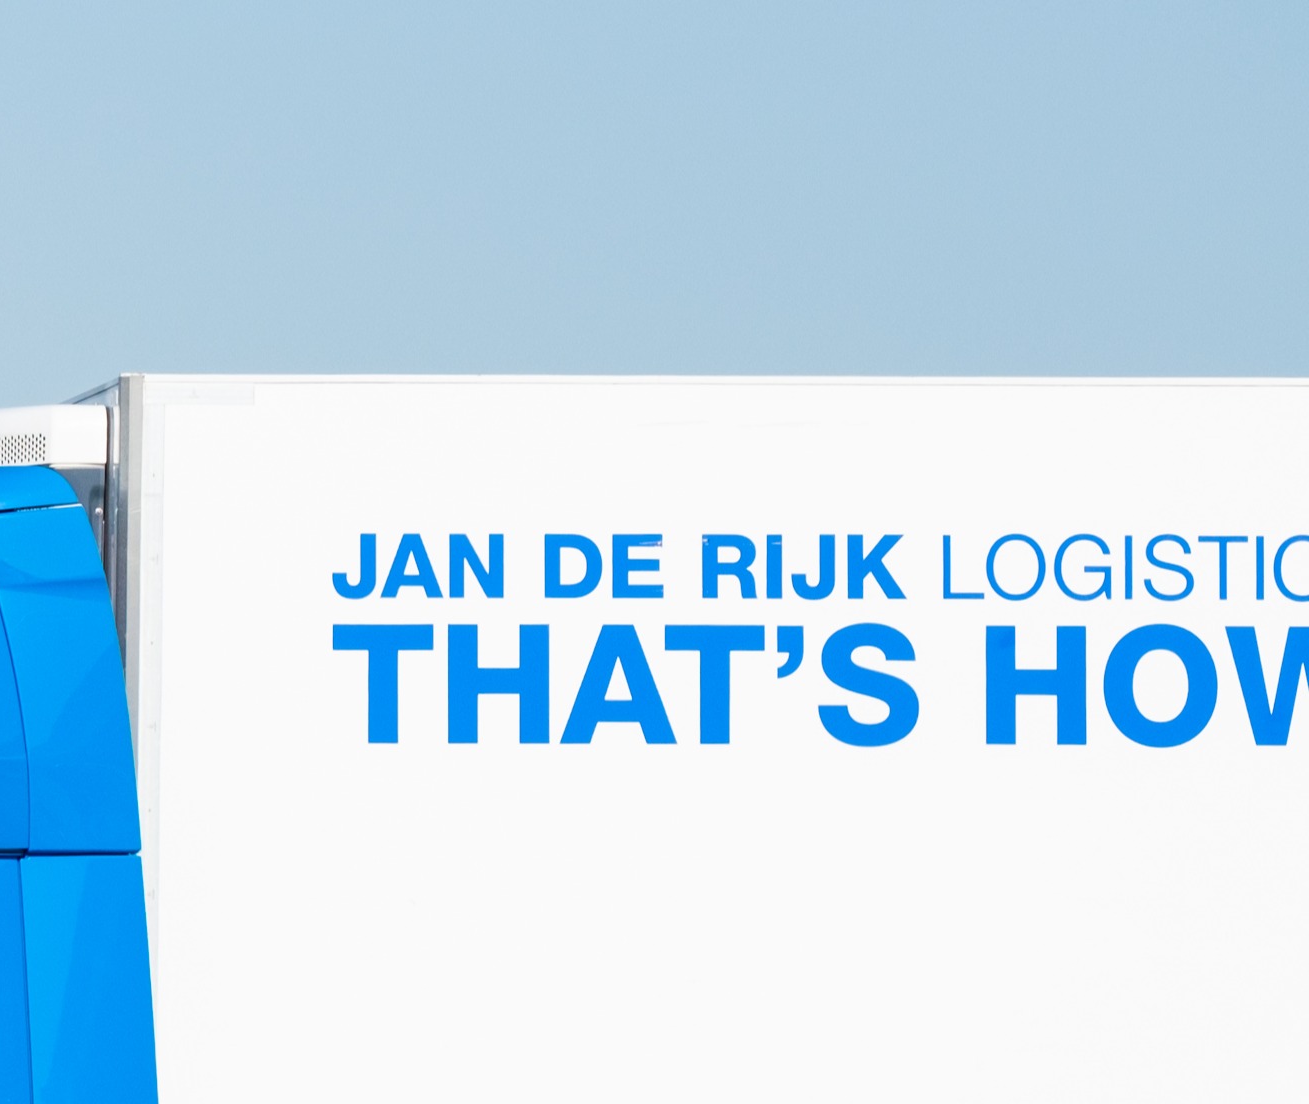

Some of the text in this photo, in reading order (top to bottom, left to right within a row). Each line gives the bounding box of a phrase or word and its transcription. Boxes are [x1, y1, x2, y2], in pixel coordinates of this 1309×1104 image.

[331, 532, 505, 600] JAN
[543, 533, 665, 599] DE
[701, 533, 907, 601] RIJK
[332, 622, 920, 748] THAT'S
